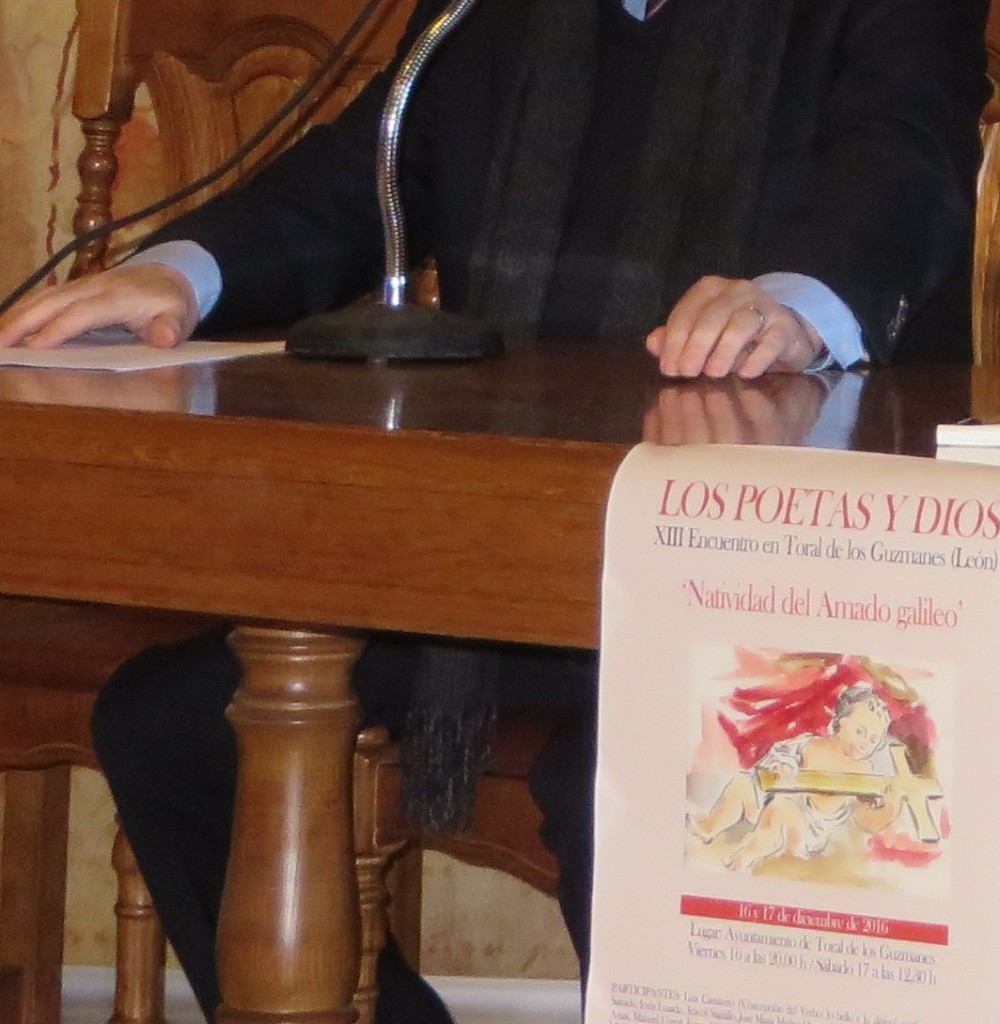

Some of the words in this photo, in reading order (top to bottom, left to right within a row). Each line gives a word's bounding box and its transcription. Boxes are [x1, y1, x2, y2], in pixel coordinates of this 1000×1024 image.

[658, 478, 730, 521] LOS
[732, 483, 875, 532] POETAS
[884, 493, 911, 533] Y
[653, 525, 684, 548] XIII
[687, 527, 760, 554] Encuentro
[762, 539, 780, 555] en
[784, 534, 822, 558] Toral
[825, 537, 843, 560] de
[847, 538, 867, 561] los
[870, 540, 947, 567] Guzmanes
[950, 546, 999, 572] (León)
[781, 586, 811, 617] del
[816, 590, 892, 624] Amado
[763, 906, 775, 922] 17
[845, 915, 860, 932] de
[861, 917, 890, 935] 2016
[814, 935, 844, 954] Toral
[845, 939, 860, 956] de
[862, 941, 877, 958] los
[879, 943, 937, 966] Guzmanes
[857, 961, 869, 978] 17
